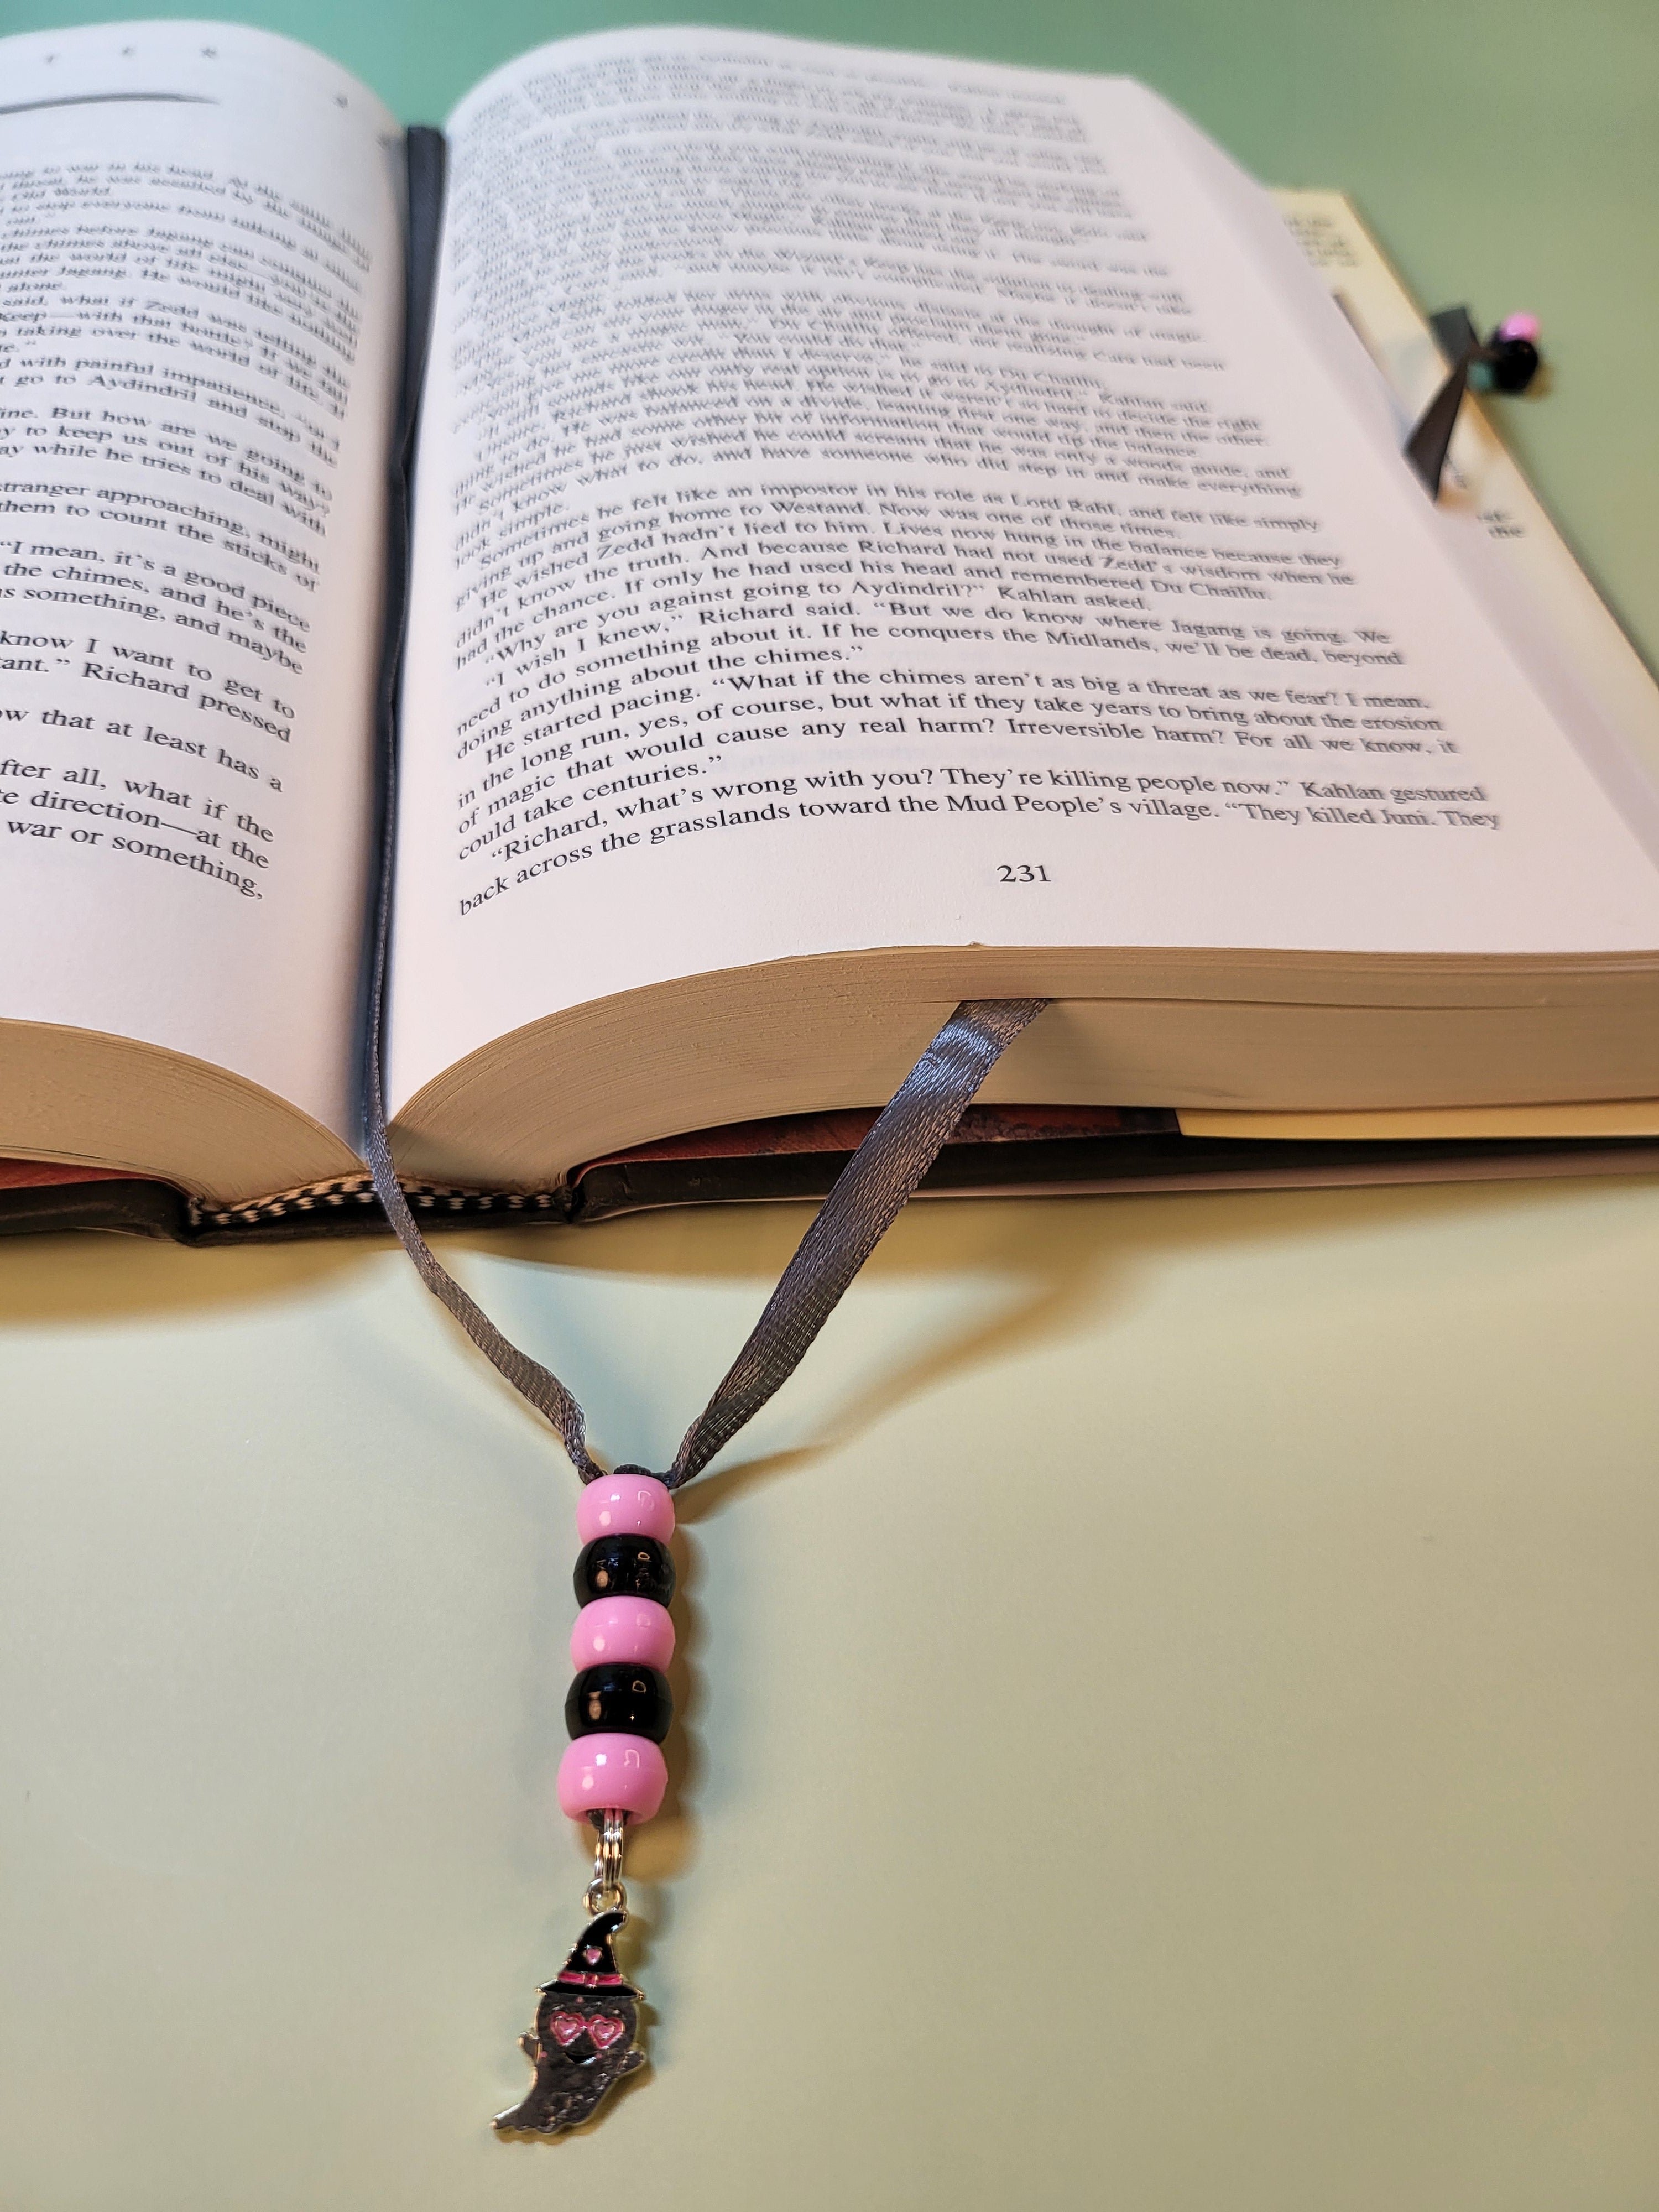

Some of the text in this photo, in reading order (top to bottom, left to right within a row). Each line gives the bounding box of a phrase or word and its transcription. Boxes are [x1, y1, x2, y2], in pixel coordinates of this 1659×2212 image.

[67, 505, 89, 516] to
[100, 511, 166, 530] count
[178, 525, 213, 543] the
[224, 540, 286, 574] sticks
[259, 533, 319, 573] might
[4, 563, 305, 651] the chimes, and he’s the
[32, 546, 104, 561] mean,
[114, 551, 155, 570] it’s
[163, 565, 177, 576] a
[184, 570, 245, 599] good
[252, 595, 310, 632] piece
[556, 619, 587, 637] are
[598, 605, 639, 627] you
[650, 588, 731, 612] against
[743, 583, 810, 601] going
[818, 582, 841, 593] to
[998, 586, 1076, 604] Kahlan
[1085, 595, 1150, 609] asked.
[24, 590, 301, 674] something, and maybe
[516, 648, 565, 674] wish
[578, 638, 586, 653] I
[699, 603, 793, 624] Richard
[943, 608, 972, 617] we
[985, 607, 1012, 619] do
[1023, 609, 1082, 624] know
[1096, 615, 1160, 629] where
[1173, 620, 1245, 638] Jagang
[1355, 632, 1387, 641] We
[0, 630, 294, 718] know I want to get to
[82, 662, 189, 699] Richard
[199, 695, 290, 742] pressed
[458, 645, 864, 758] doing anything about the chimes.”
[42, 709, 94, 729] that
[107, 723, 132, 737] at
[144, 726, 205, 758] least
[218, 749, 258, 779] has
[270, 778, 281, 792] a
[487, 742, 514, 764] He
[524, 705, 601, 745] started
[611, 688, 700, 718] pacing.
[713, 674, 796, 691] “What
[806, 670, 823, 685] if
[833, 670, 870, 684] the
[880, 669, 965, 684] chimes
[975, 673, 1043, 687] aren’t
[1052, 679, 1074, 688] as
[1081, 676, 1120, 695] big
[1128, 683, 1140, 692] a
[1147, 681, 1211, 697] threat
[1220, 690, 1240, 698] as
[1249, 692, 1277, 702] we
[1286, 690, 1336, 705] fear?
[1346, 693, 1356, 706] I
[63, 768, 106, 788] all,
[124, 780, 191, 808] what
[204, 799, 229, 820] if
[237, 810, 273, 842] the
[459, 808, 479, 833] of
[488, 775, 554, 815] magic
[567, 755, 613, 779] that
[625, 732, 703, 761] would
[717, 727, 789, 744] cause
[802, 723, 845, 738] any
[859, 717, 906, 733] real
[917, 717, 994, 733] harm?
[1007, 718, 1144, 739] Irreversible
[1152, 726, 1222, 743] harm?
[1234, 732, 1271, 747] For
[1286, 735, 1311, 749] all
[1321, 740, 1352, 750] we
[1441, 742, 1455, 753] it
[460, 755, 722, 860] could take centuries.”
[492, 768, 1485, 860] “Richard, what’s wrong with you? They’re killing people now.” Kahlan gestured
[8, 821, 262, 899] war or something,
[232, 842, 268, 868] the
[460, 795, 1496, 915] back across the grasslands toward the Mud People’s village. “They killed Juni. They
[998, 865, 1051, 882] 231
